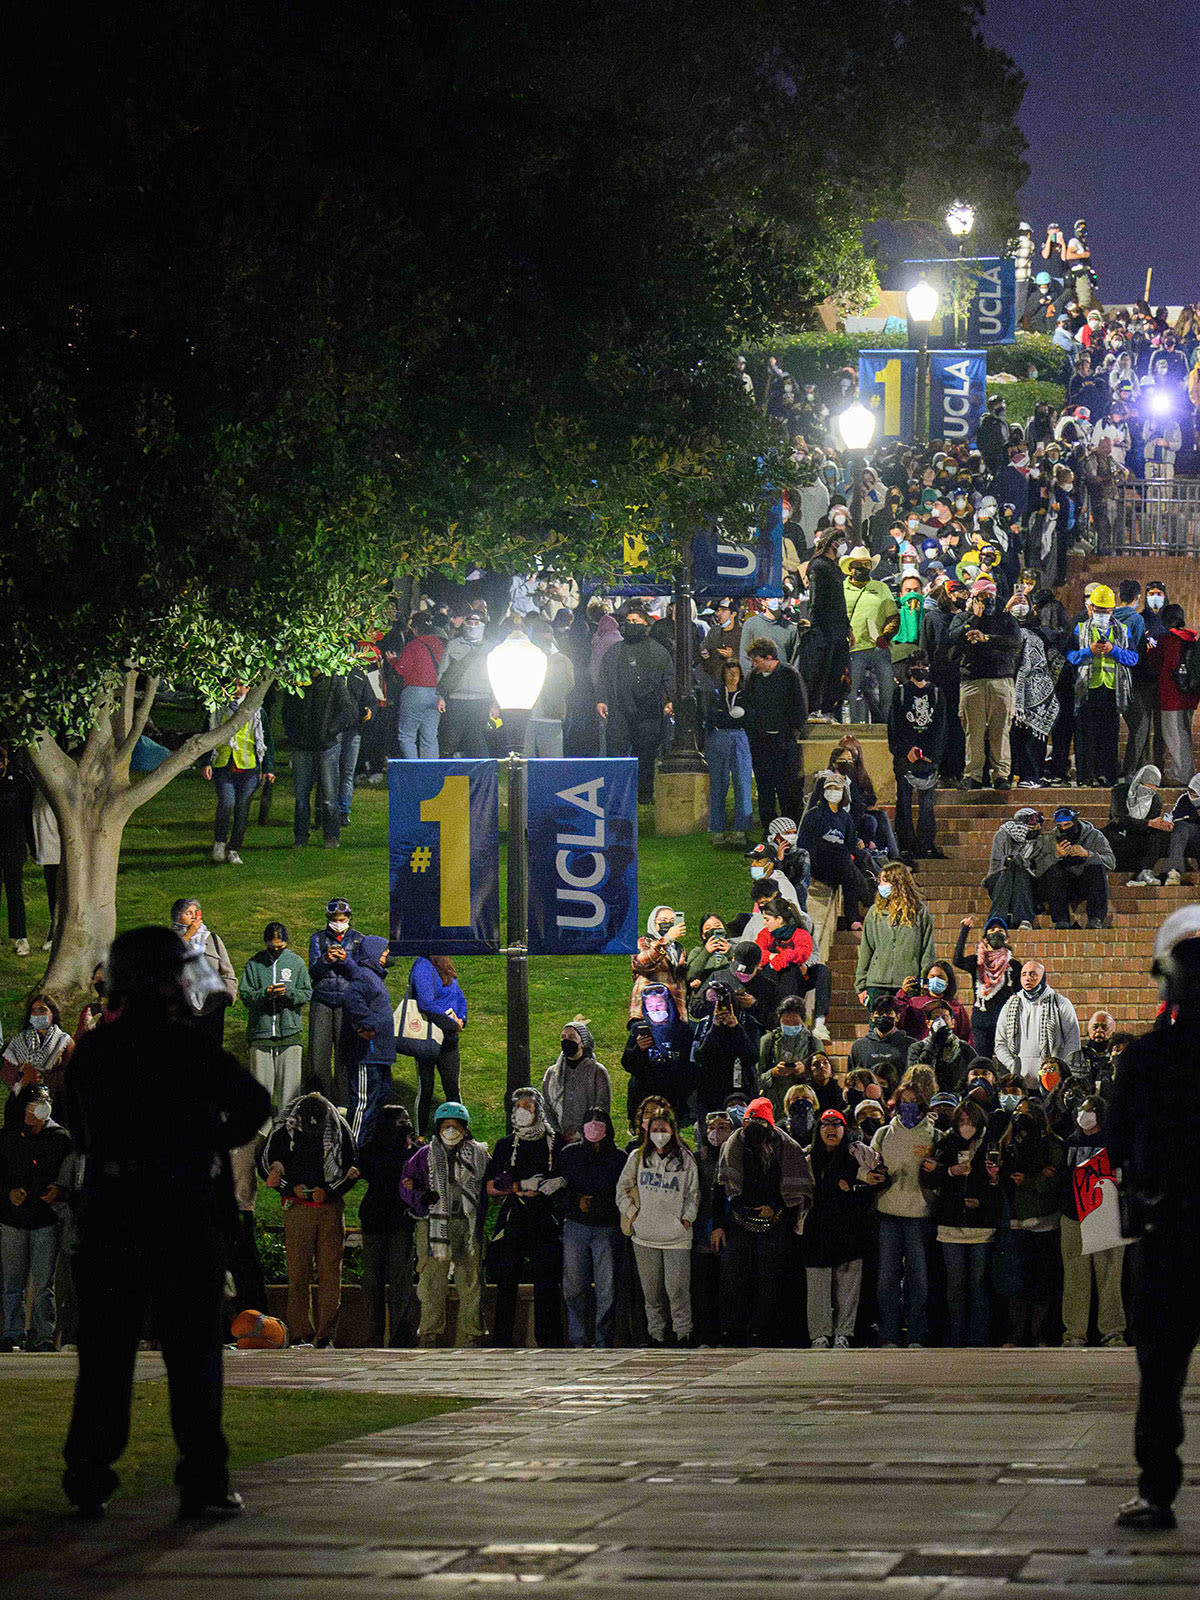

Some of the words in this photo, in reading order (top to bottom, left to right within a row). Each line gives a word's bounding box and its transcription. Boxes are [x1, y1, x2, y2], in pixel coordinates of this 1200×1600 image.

[979, 266, 1002, 335] UCLA
[870, 359, 901, 436] #1
[943, 360, 970, 438] UCLA
[409, 775, 471, 927] #1
[555, 776, 606, 928] UCLA
[640, 1171, 680, 1192] UCLA
